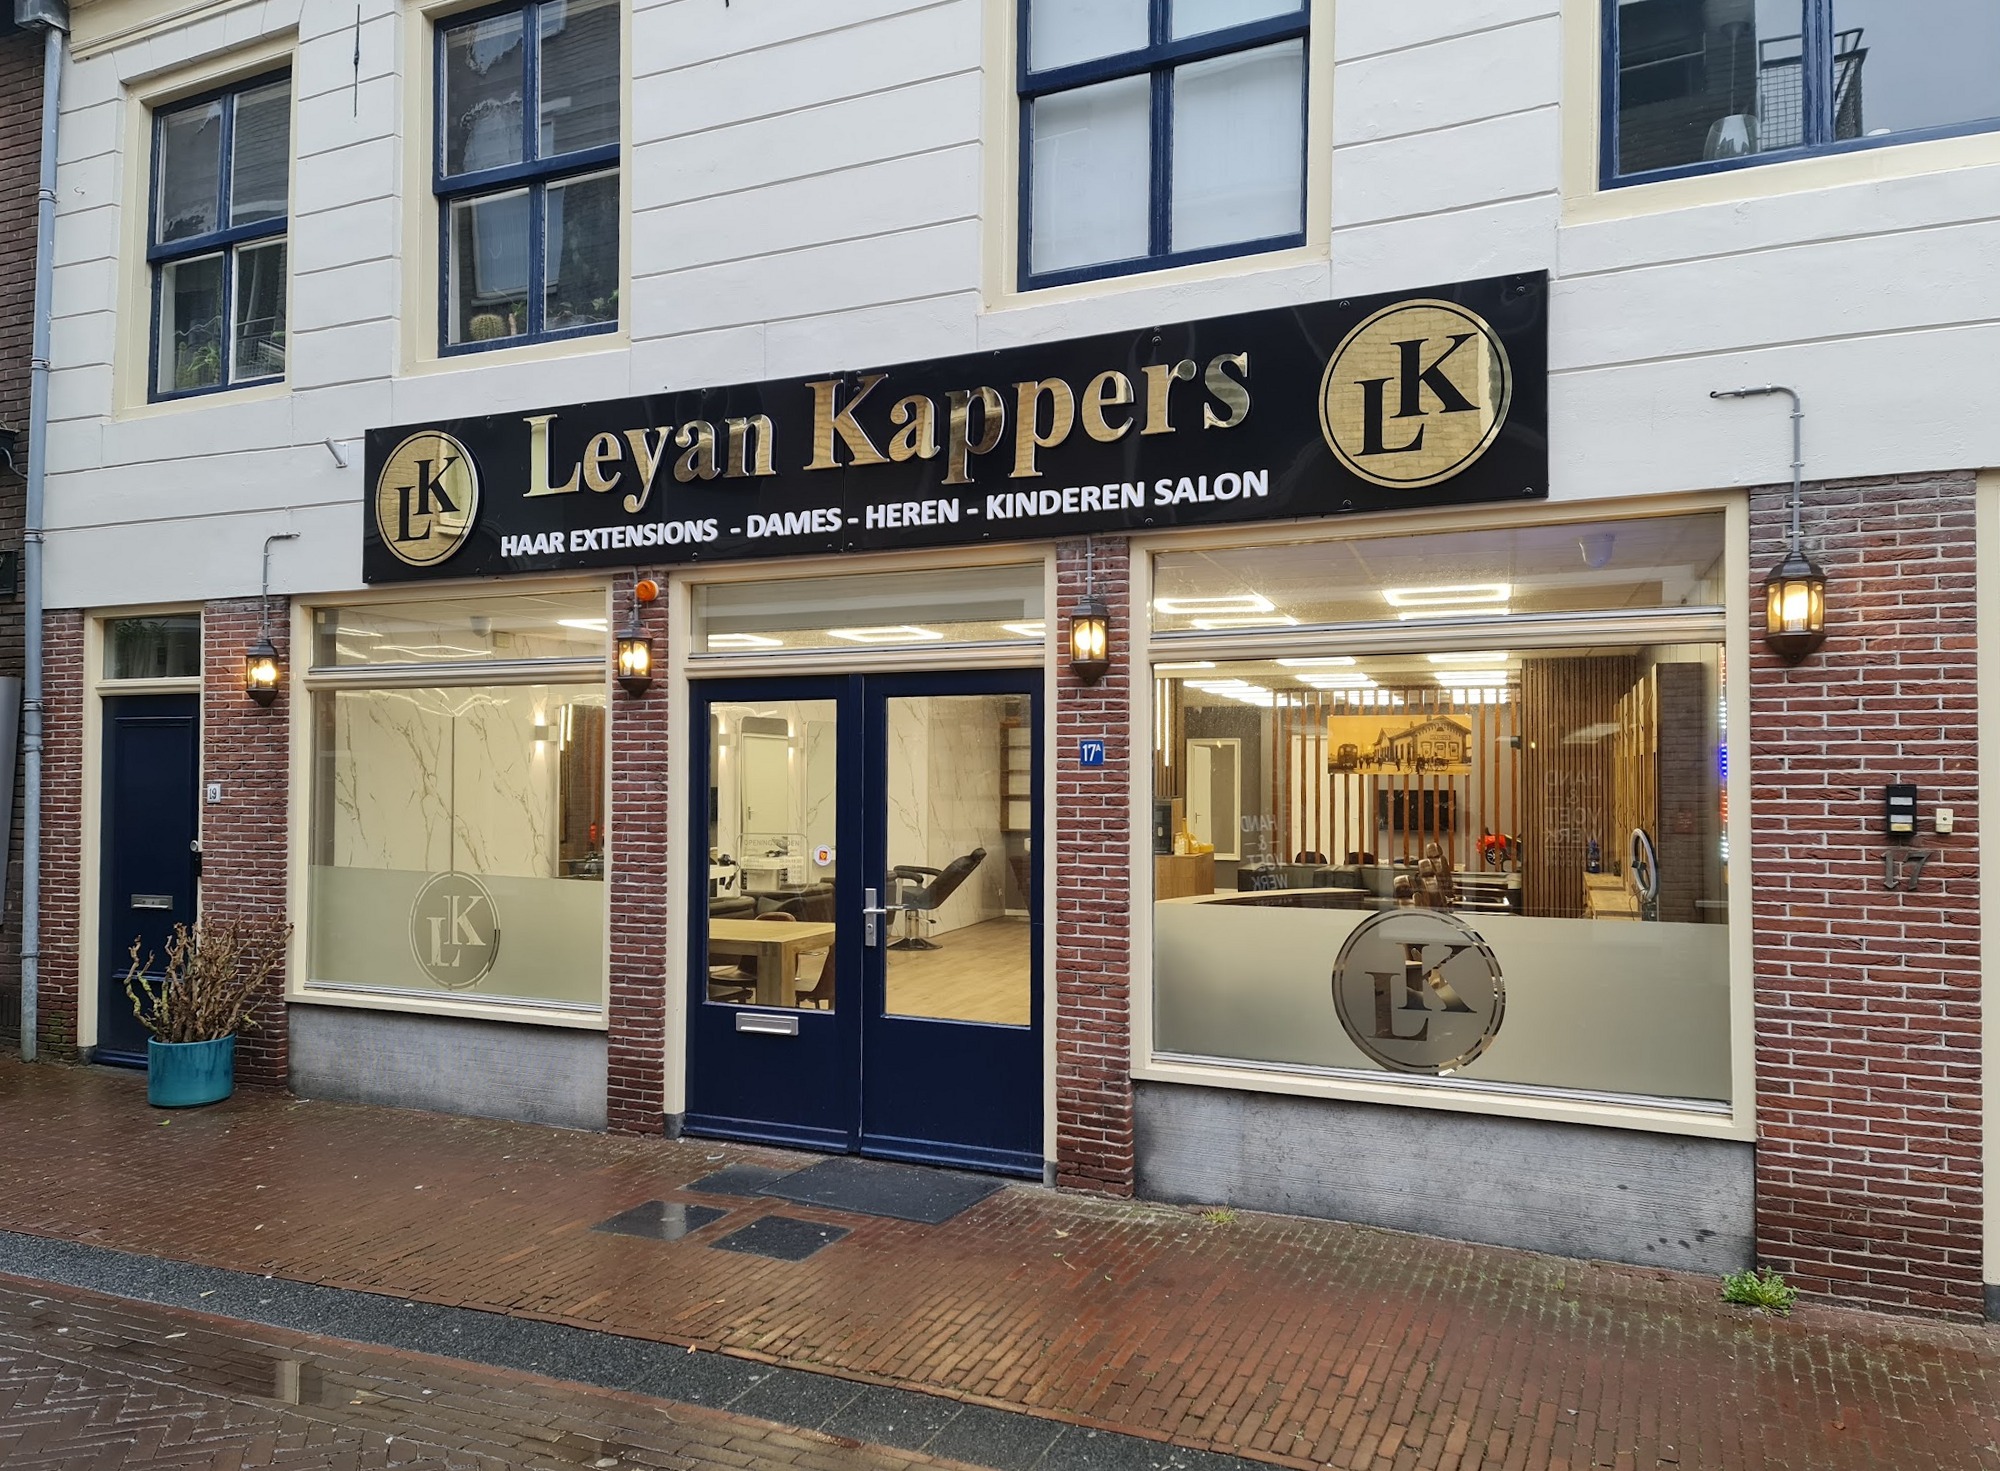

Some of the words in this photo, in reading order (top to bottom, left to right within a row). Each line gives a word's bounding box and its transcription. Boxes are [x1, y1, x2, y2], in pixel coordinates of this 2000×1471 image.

[522, 412, 778, 515] Leyan
[803, 351, 1253, 485] Kappers
[1353, 332, 1481, 457] LK
[395, 456, 460, 543] LK
[500, 531, 566, 558] HAAR
[569, 519, 718, 552] EXTENSIONS
[747, 507, 842, 538] DAMES
[865, 498, 959, 530] HEREN
[986, 481, 1146, 520] KINDEREN
[1153, 469, 1270, 506] SALON
[209, 787, 217, 800] 19
[1881, 849, 1931, 891] 17
